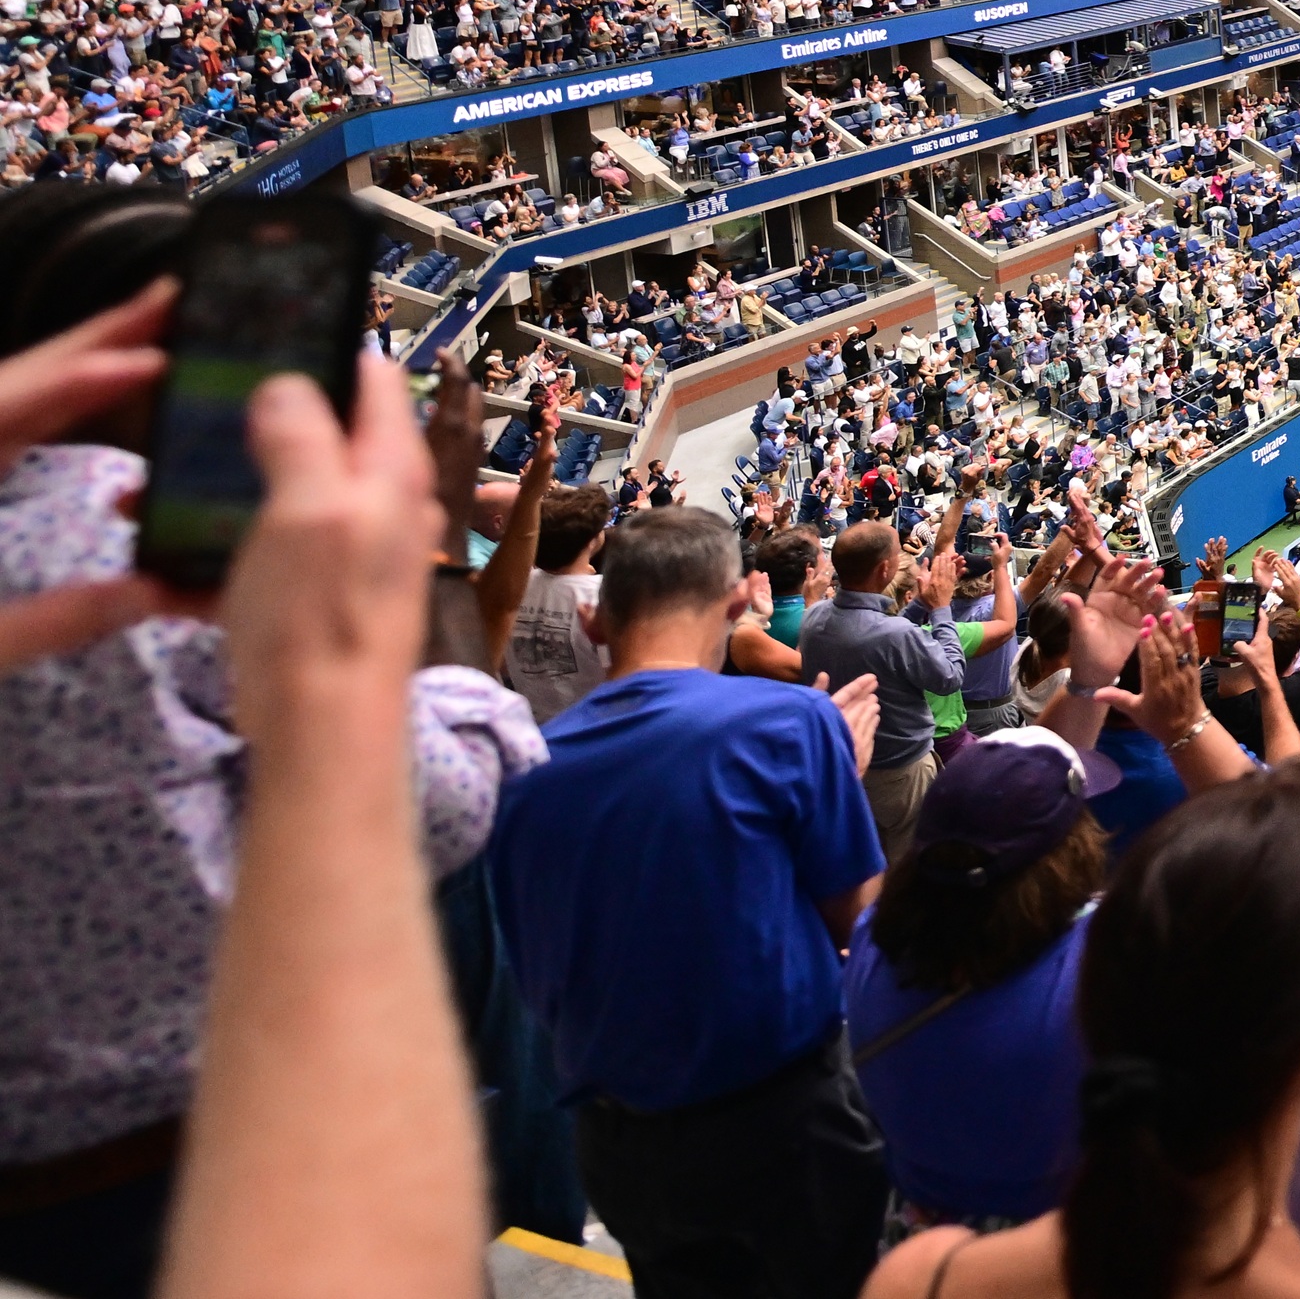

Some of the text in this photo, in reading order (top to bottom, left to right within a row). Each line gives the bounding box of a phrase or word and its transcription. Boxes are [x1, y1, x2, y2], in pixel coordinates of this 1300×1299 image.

[974, 1, 1029, 23] #USOPEN
[781, 28, 888, 60] Emirates Airline
[1248, 43, 1300, 64] POLO RALPH LAUREN
[453, 70, 654, 124] AMERICAN EXPRESS
[1106, 86, 1136, 102] ESPN
[911, 129, 979, 156] THERE'S ONLY ONE DC
[686, 193, 729, 222] IBM
[1251, 433, 1288, 463] Emirates
[1260, 449, 1280, 466] Airline
